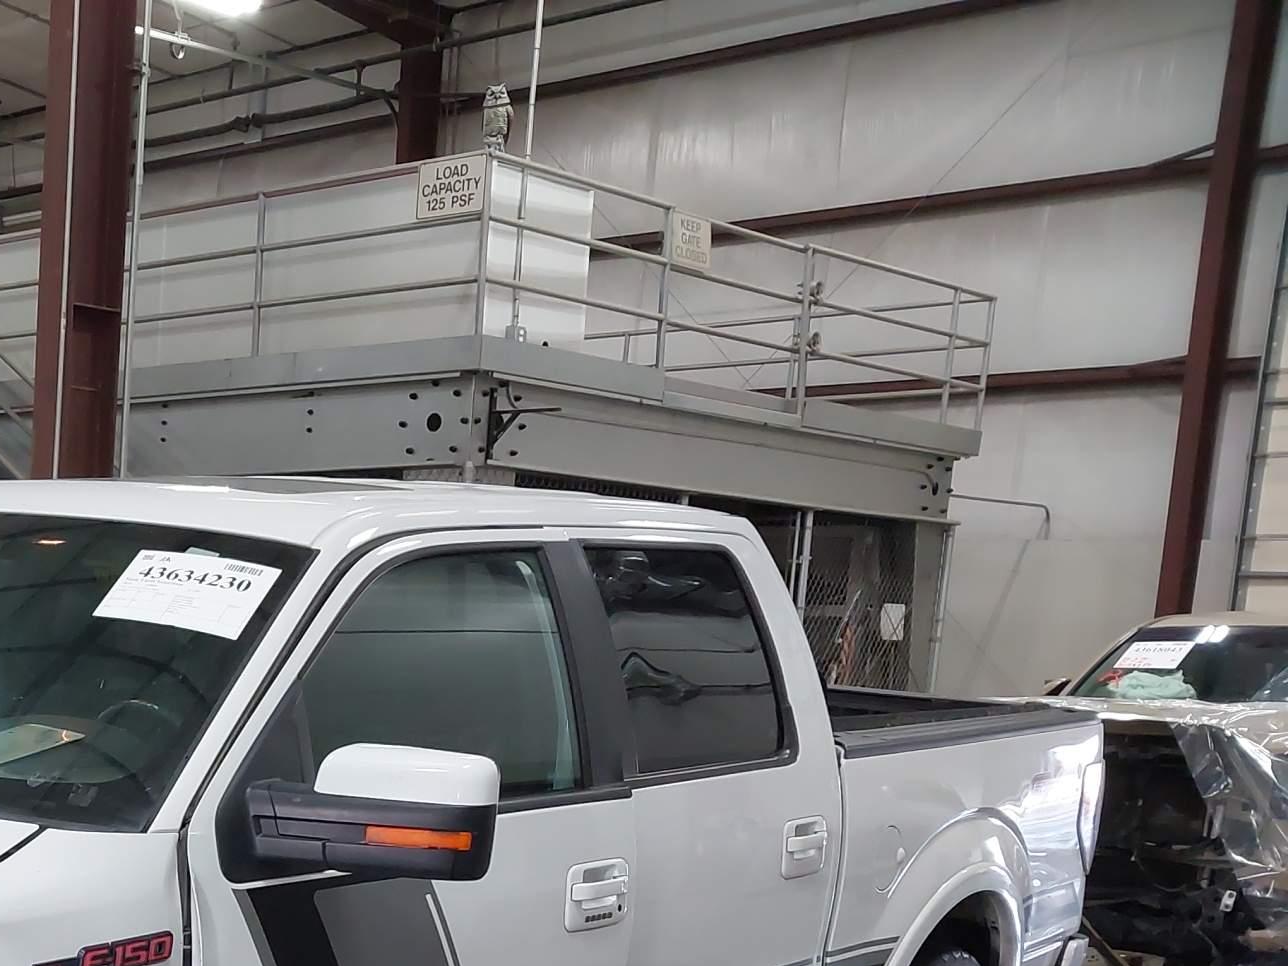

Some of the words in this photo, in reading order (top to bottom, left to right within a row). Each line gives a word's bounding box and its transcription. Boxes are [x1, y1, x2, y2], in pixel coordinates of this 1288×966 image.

[436, 163, 469, 181] LOAD
[422, 176, 482, 198] CAPACITY
[426, 196, 446, 212] 125
[451, 192, 475, 209] PSF
[680, 217, 702, 232] KEEP
[681, 232, 702, 249] GATE
[674, 245, 709, 265] CLOSED
[138, 565, 252, 593] 43634230
